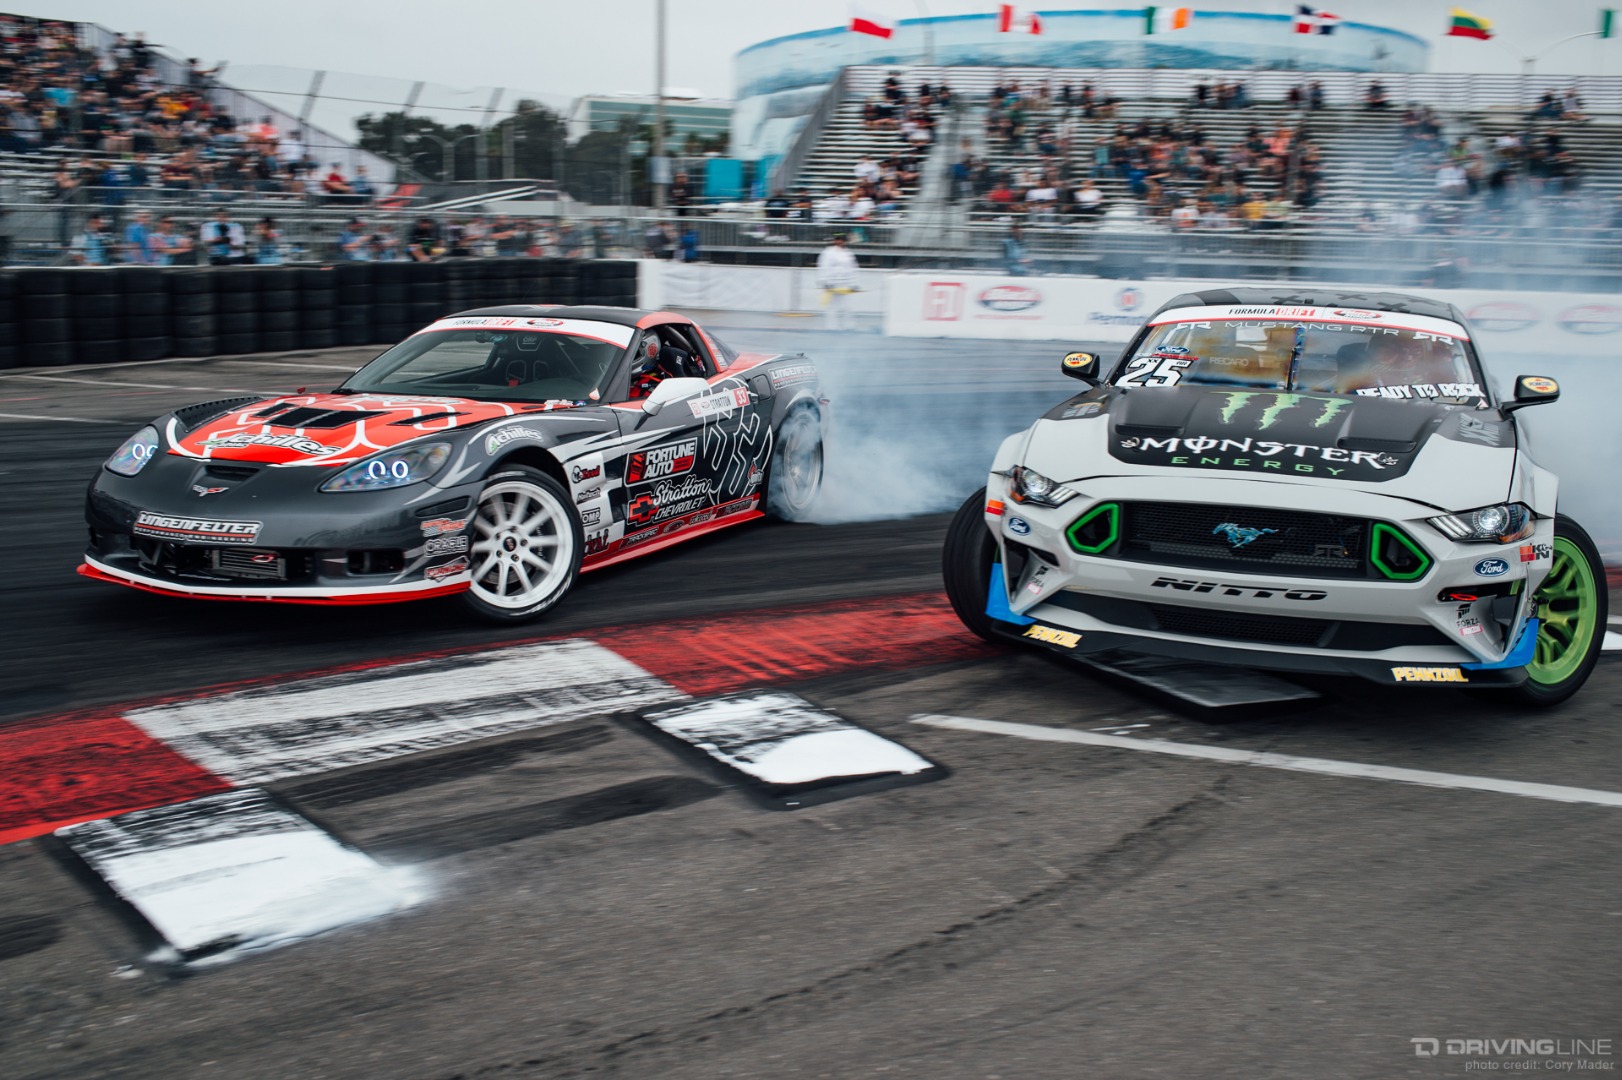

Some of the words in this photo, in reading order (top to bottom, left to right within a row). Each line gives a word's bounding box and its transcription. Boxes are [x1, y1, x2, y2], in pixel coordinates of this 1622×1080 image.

[1228, 308, 1275, 316] FORMULA
[1225, 321, 1342, 331] MUSTANG
[1350, 325, 1399, 336] RTR
[1115, 357, 1194, 387] 25
[1209, 357, 1249, 367] RECARO
[736, 389, 747, 405] 33
[1356, 384, 1413, 399] READY
[1411, 384, 1439, 400] TO
[489, 427, 543, 455] Achilles
[645, 441, 696, 466] FORTUNE
[1140, 435, 1386, 470] MONSTER
[643, 460, 675, 480] AUTO
[1171, 456, 1345, 476] ENERGY
[653, 478, 711, 506] Stratton
[582, 511, 601, 523] OMP
[655, 496, 706, 520] CHEVROLET
[137, 513, 261, 534] LINGENFELTER
[1480, 559, 1505, 574] Ford
[1151, 577, 1328, 600] NITTO
[1456, 618, 1480, 627] FORZA
[1391, 667, 1469, 682] PENNZOIL
